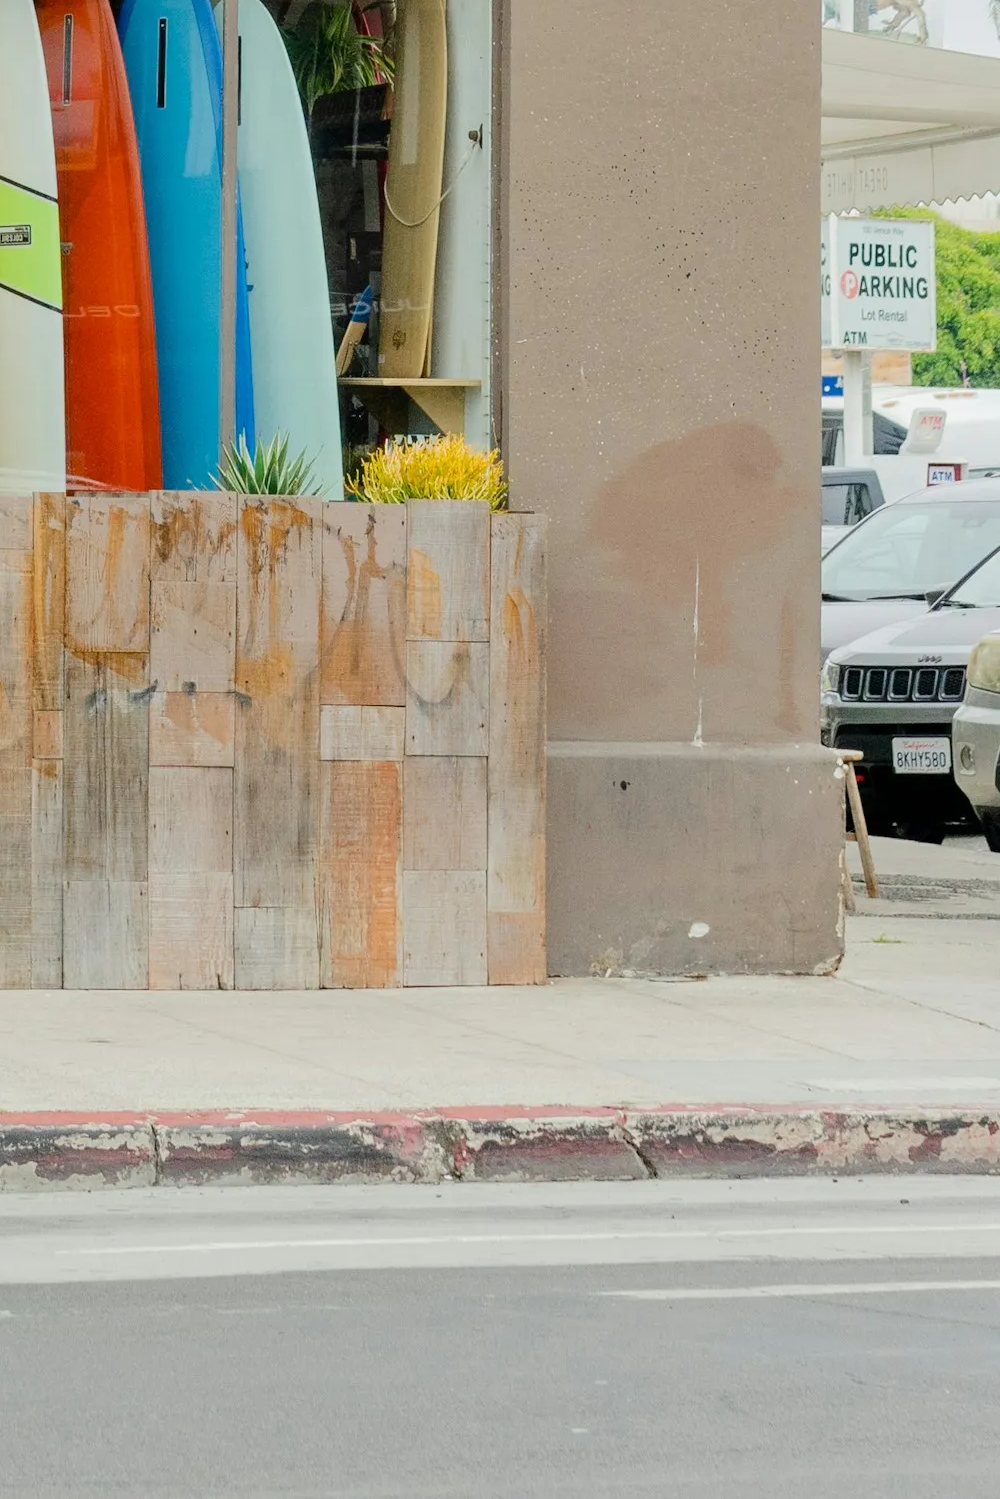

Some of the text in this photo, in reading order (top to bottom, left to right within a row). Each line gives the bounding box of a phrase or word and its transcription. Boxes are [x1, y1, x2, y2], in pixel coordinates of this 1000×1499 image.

[849, 243, 918, 268] PUBLIC
[841, 271, 928, 299] PARKING
[861, 308, 908, 322] Lot Rental
[843, 331, 867, 344] ATM
[921, 416, 943, 426] ATM
[932, 471, 952, 482] ATM
[896, 751, 947, 768] 8KHY580
